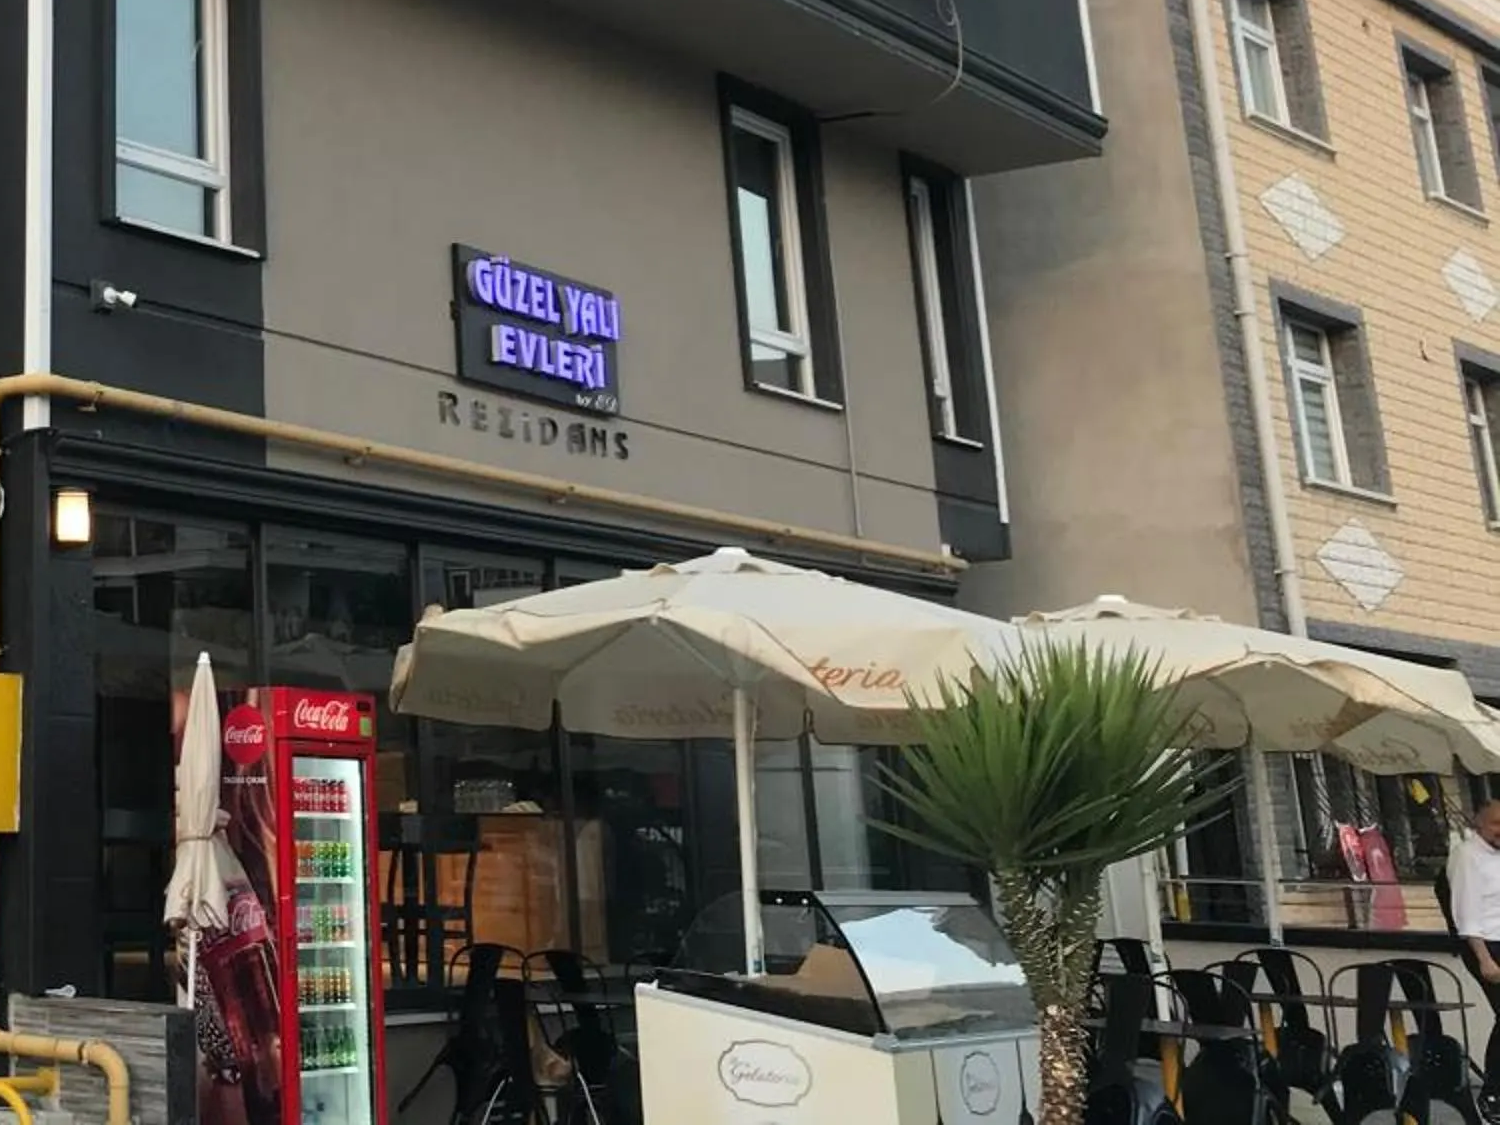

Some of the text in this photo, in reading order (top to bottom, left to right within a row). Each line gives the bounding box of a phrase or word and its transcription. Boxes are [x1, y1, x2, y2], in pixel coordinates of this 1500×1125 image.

[467, 254, 621, 341] GÜZEL YALI
[491, 323, 606, 389] EVLERİ
